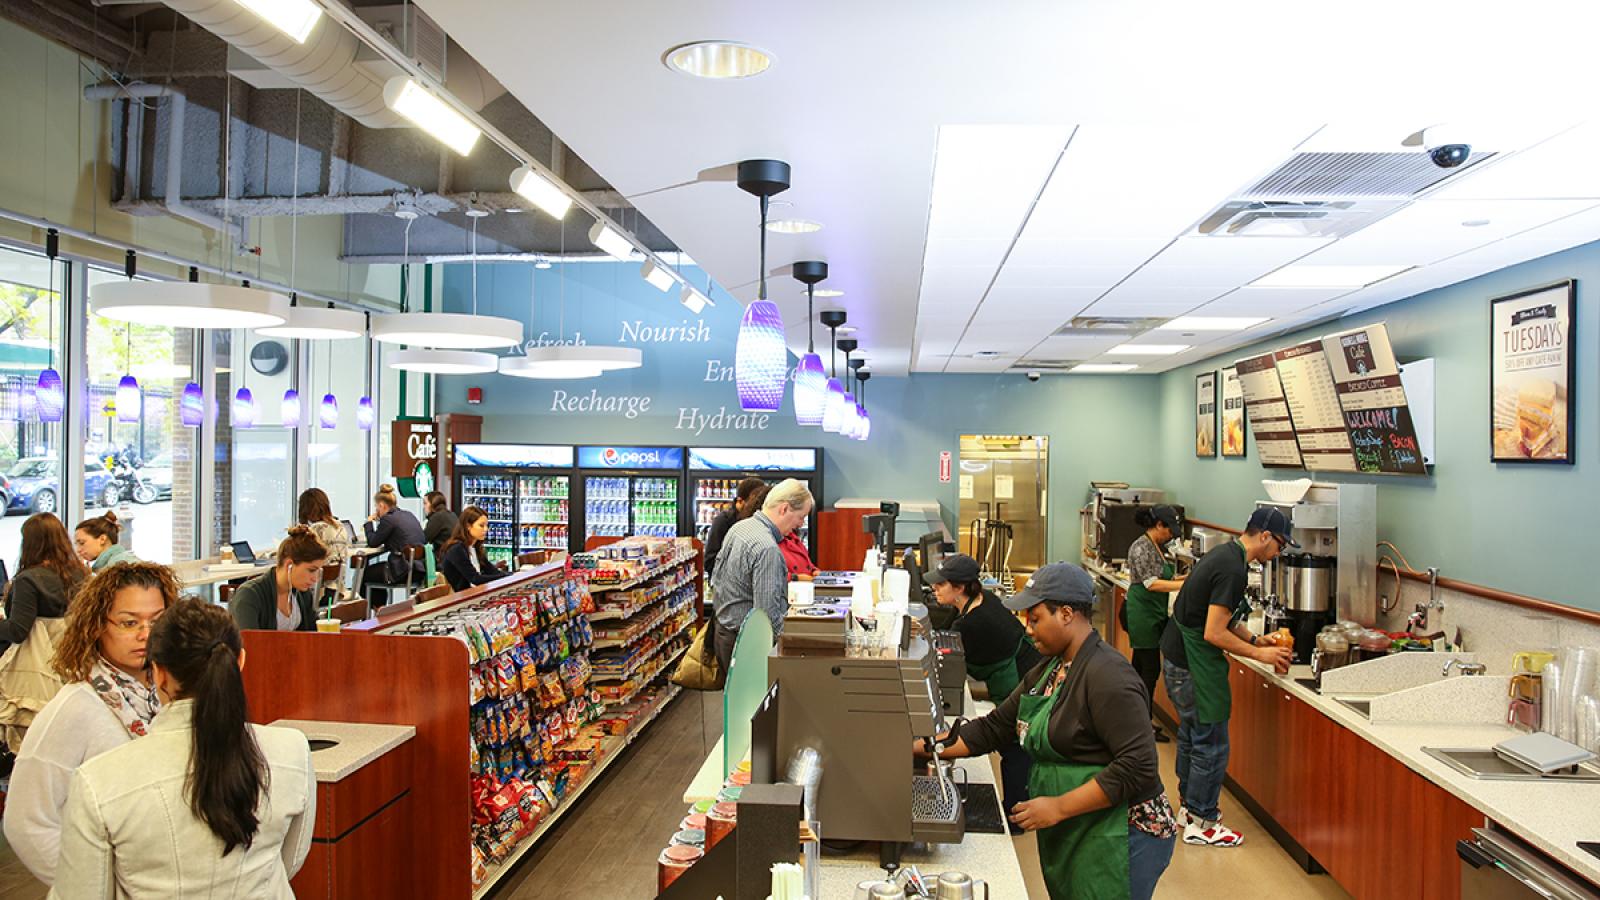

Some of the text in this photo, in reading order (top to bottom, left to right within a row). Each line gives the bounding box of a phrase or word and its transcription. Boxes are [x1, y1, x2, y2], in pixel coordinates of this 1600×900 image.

[618, 319, 711, 343] Nourish
[1503, 321, 1563, 353] TUESDAYS
[551, 389, 651, 419] Recharge
[675, 406, 769, 436] Hydrate
[407, 433, 437, 460] Café
[1389, 432, 1416, 450] BACON
[620, 449, 661, 465] pepsi
